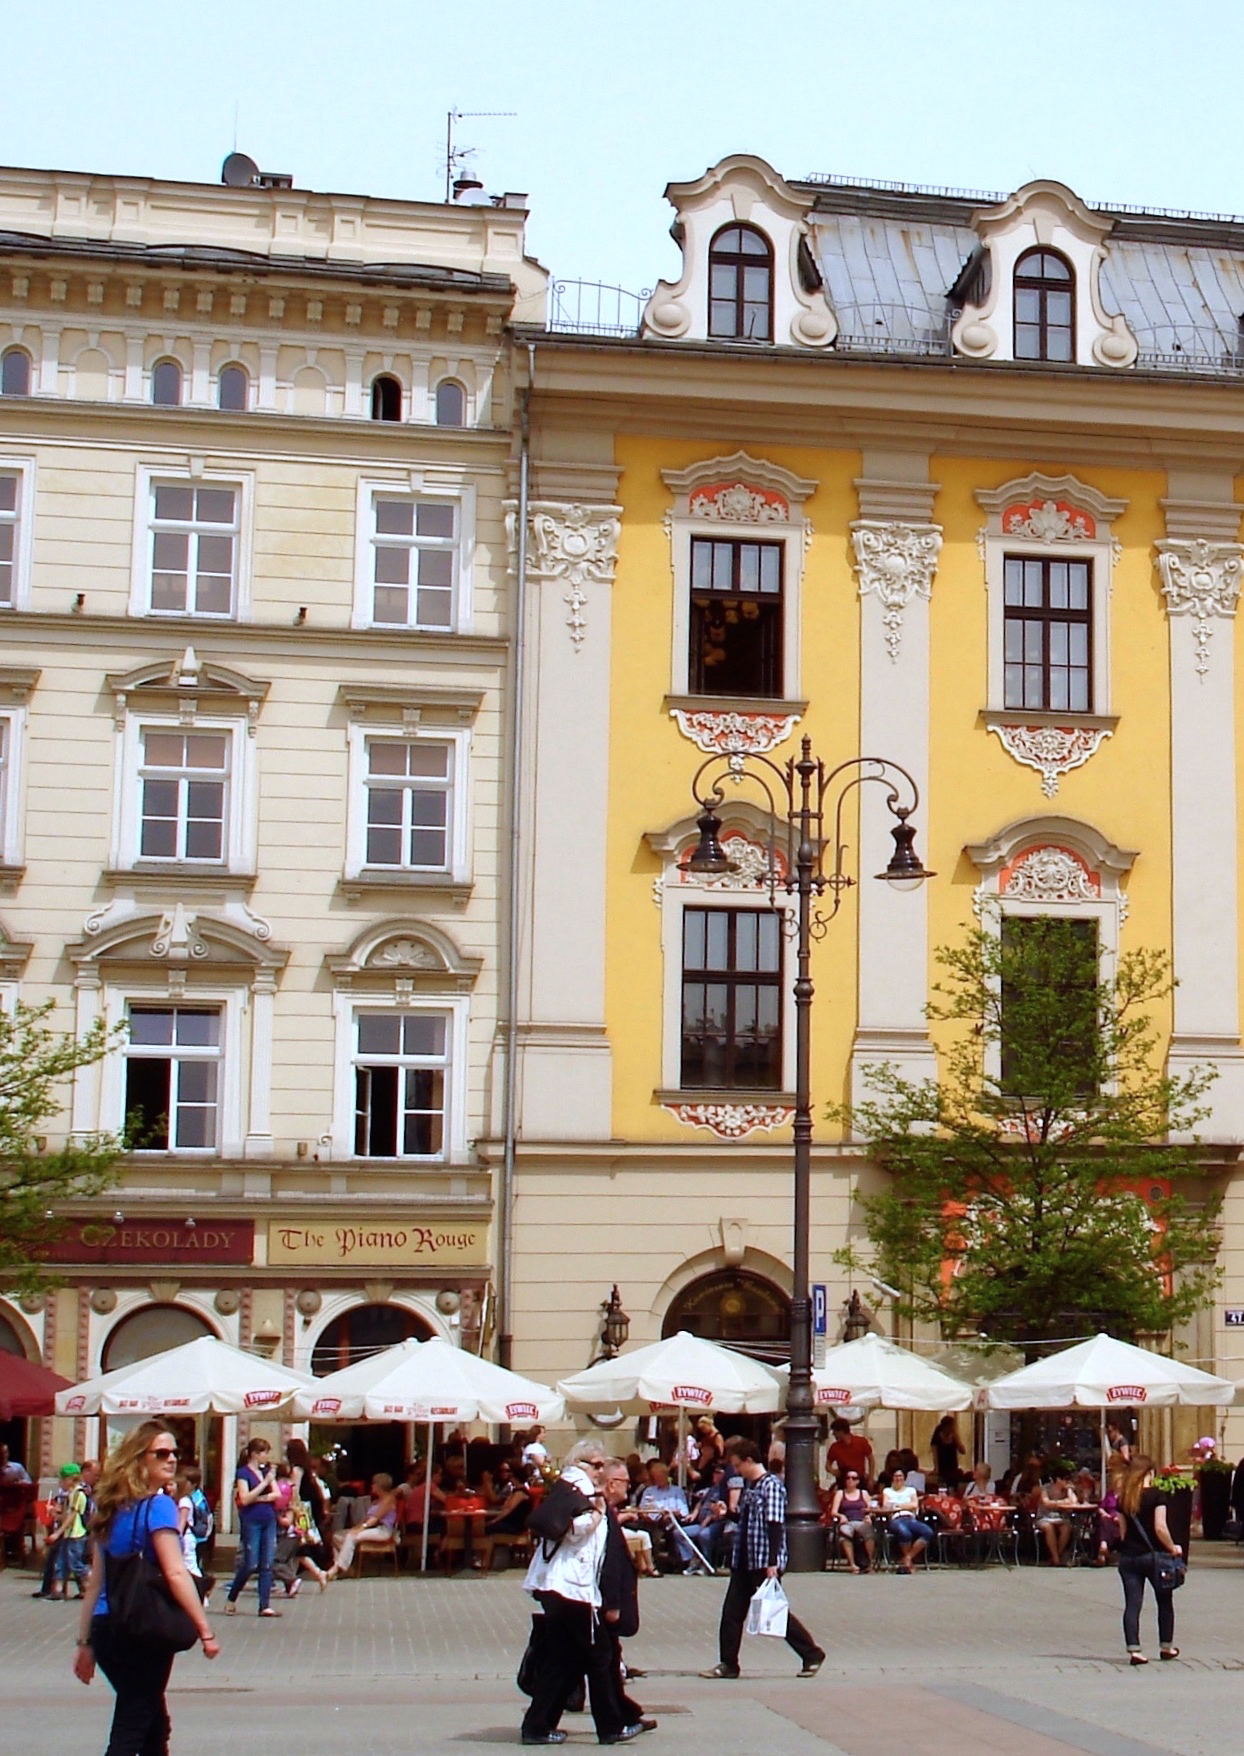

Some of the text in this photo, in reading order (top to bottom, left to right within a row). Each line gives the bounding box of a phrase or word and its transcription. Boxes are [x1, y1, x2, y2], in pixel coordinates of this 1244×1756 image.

[80, 1225, 236, 1249] CZEKOLADY
[278, 1227, 475, 1257] The Piano Rouge
[815, 1289, 825, 1329] P
